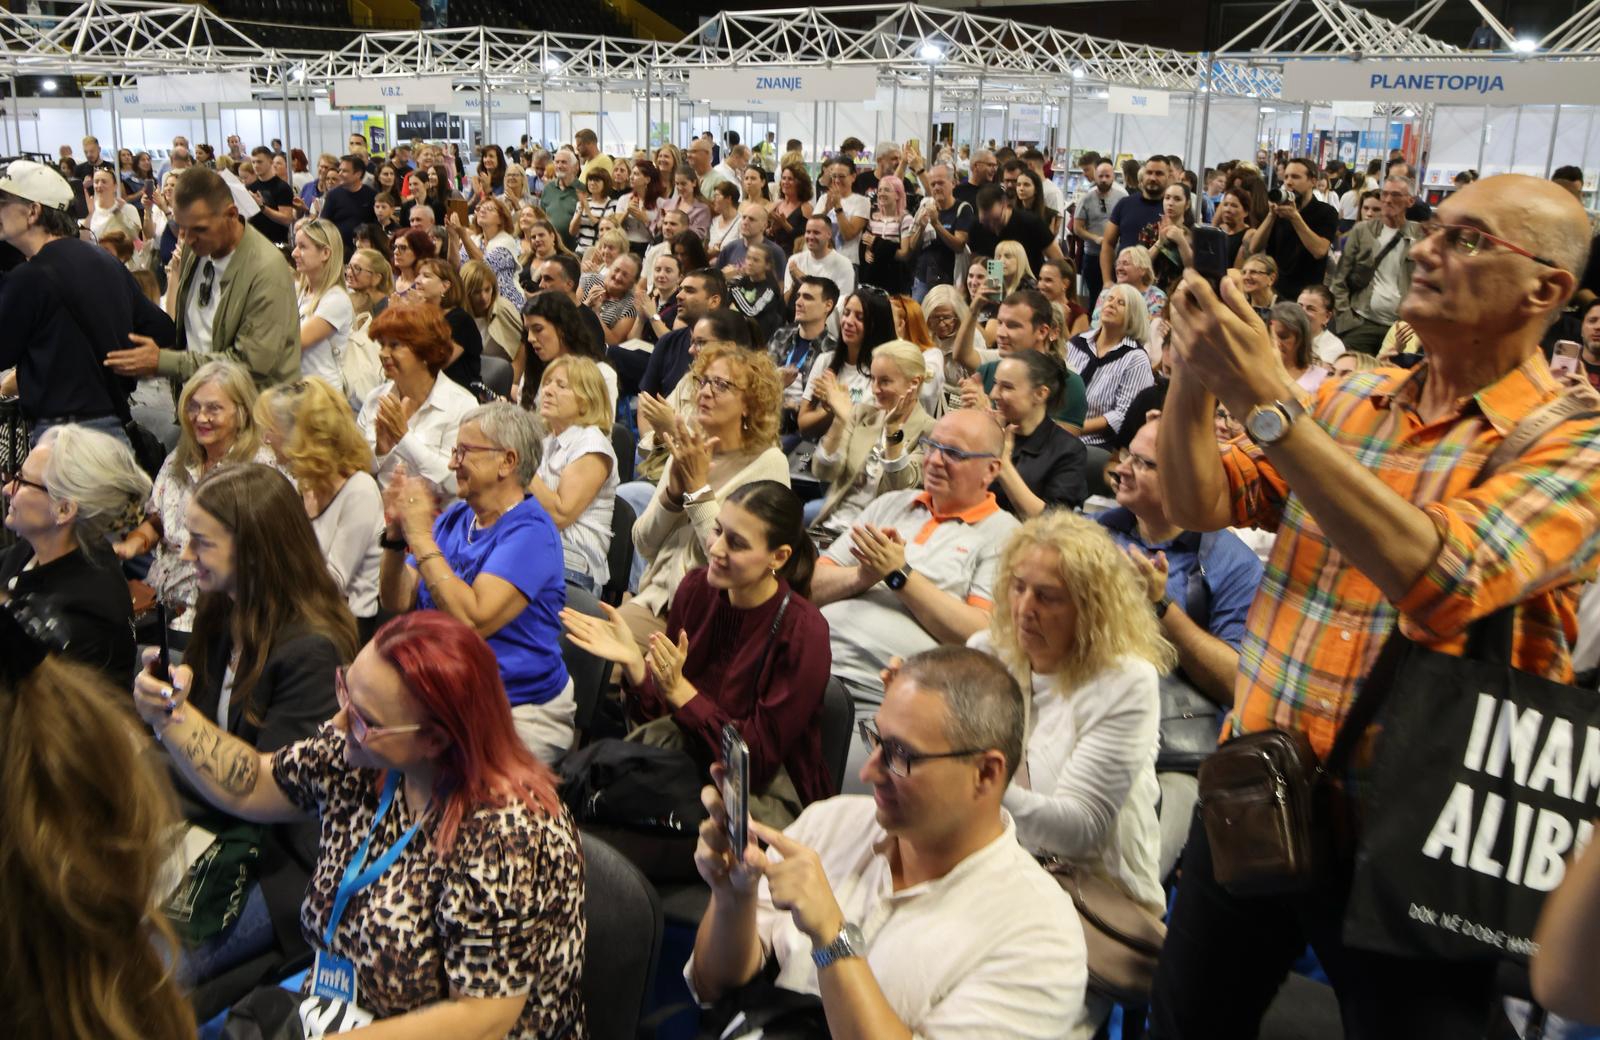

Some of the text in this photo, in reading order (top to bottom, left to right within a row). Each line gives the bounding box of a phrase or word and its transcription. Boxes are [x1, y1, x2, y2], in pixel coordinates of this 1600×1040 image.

[381, 86, 403, 96] V.B.Z.
[756, 77, 802, 92] ZNANJE
[1370, 74, 1504, 94] PLANETOPIJA
[435, 120, 460, 128] STIUS
[319, 967, 350, 994] mfk
